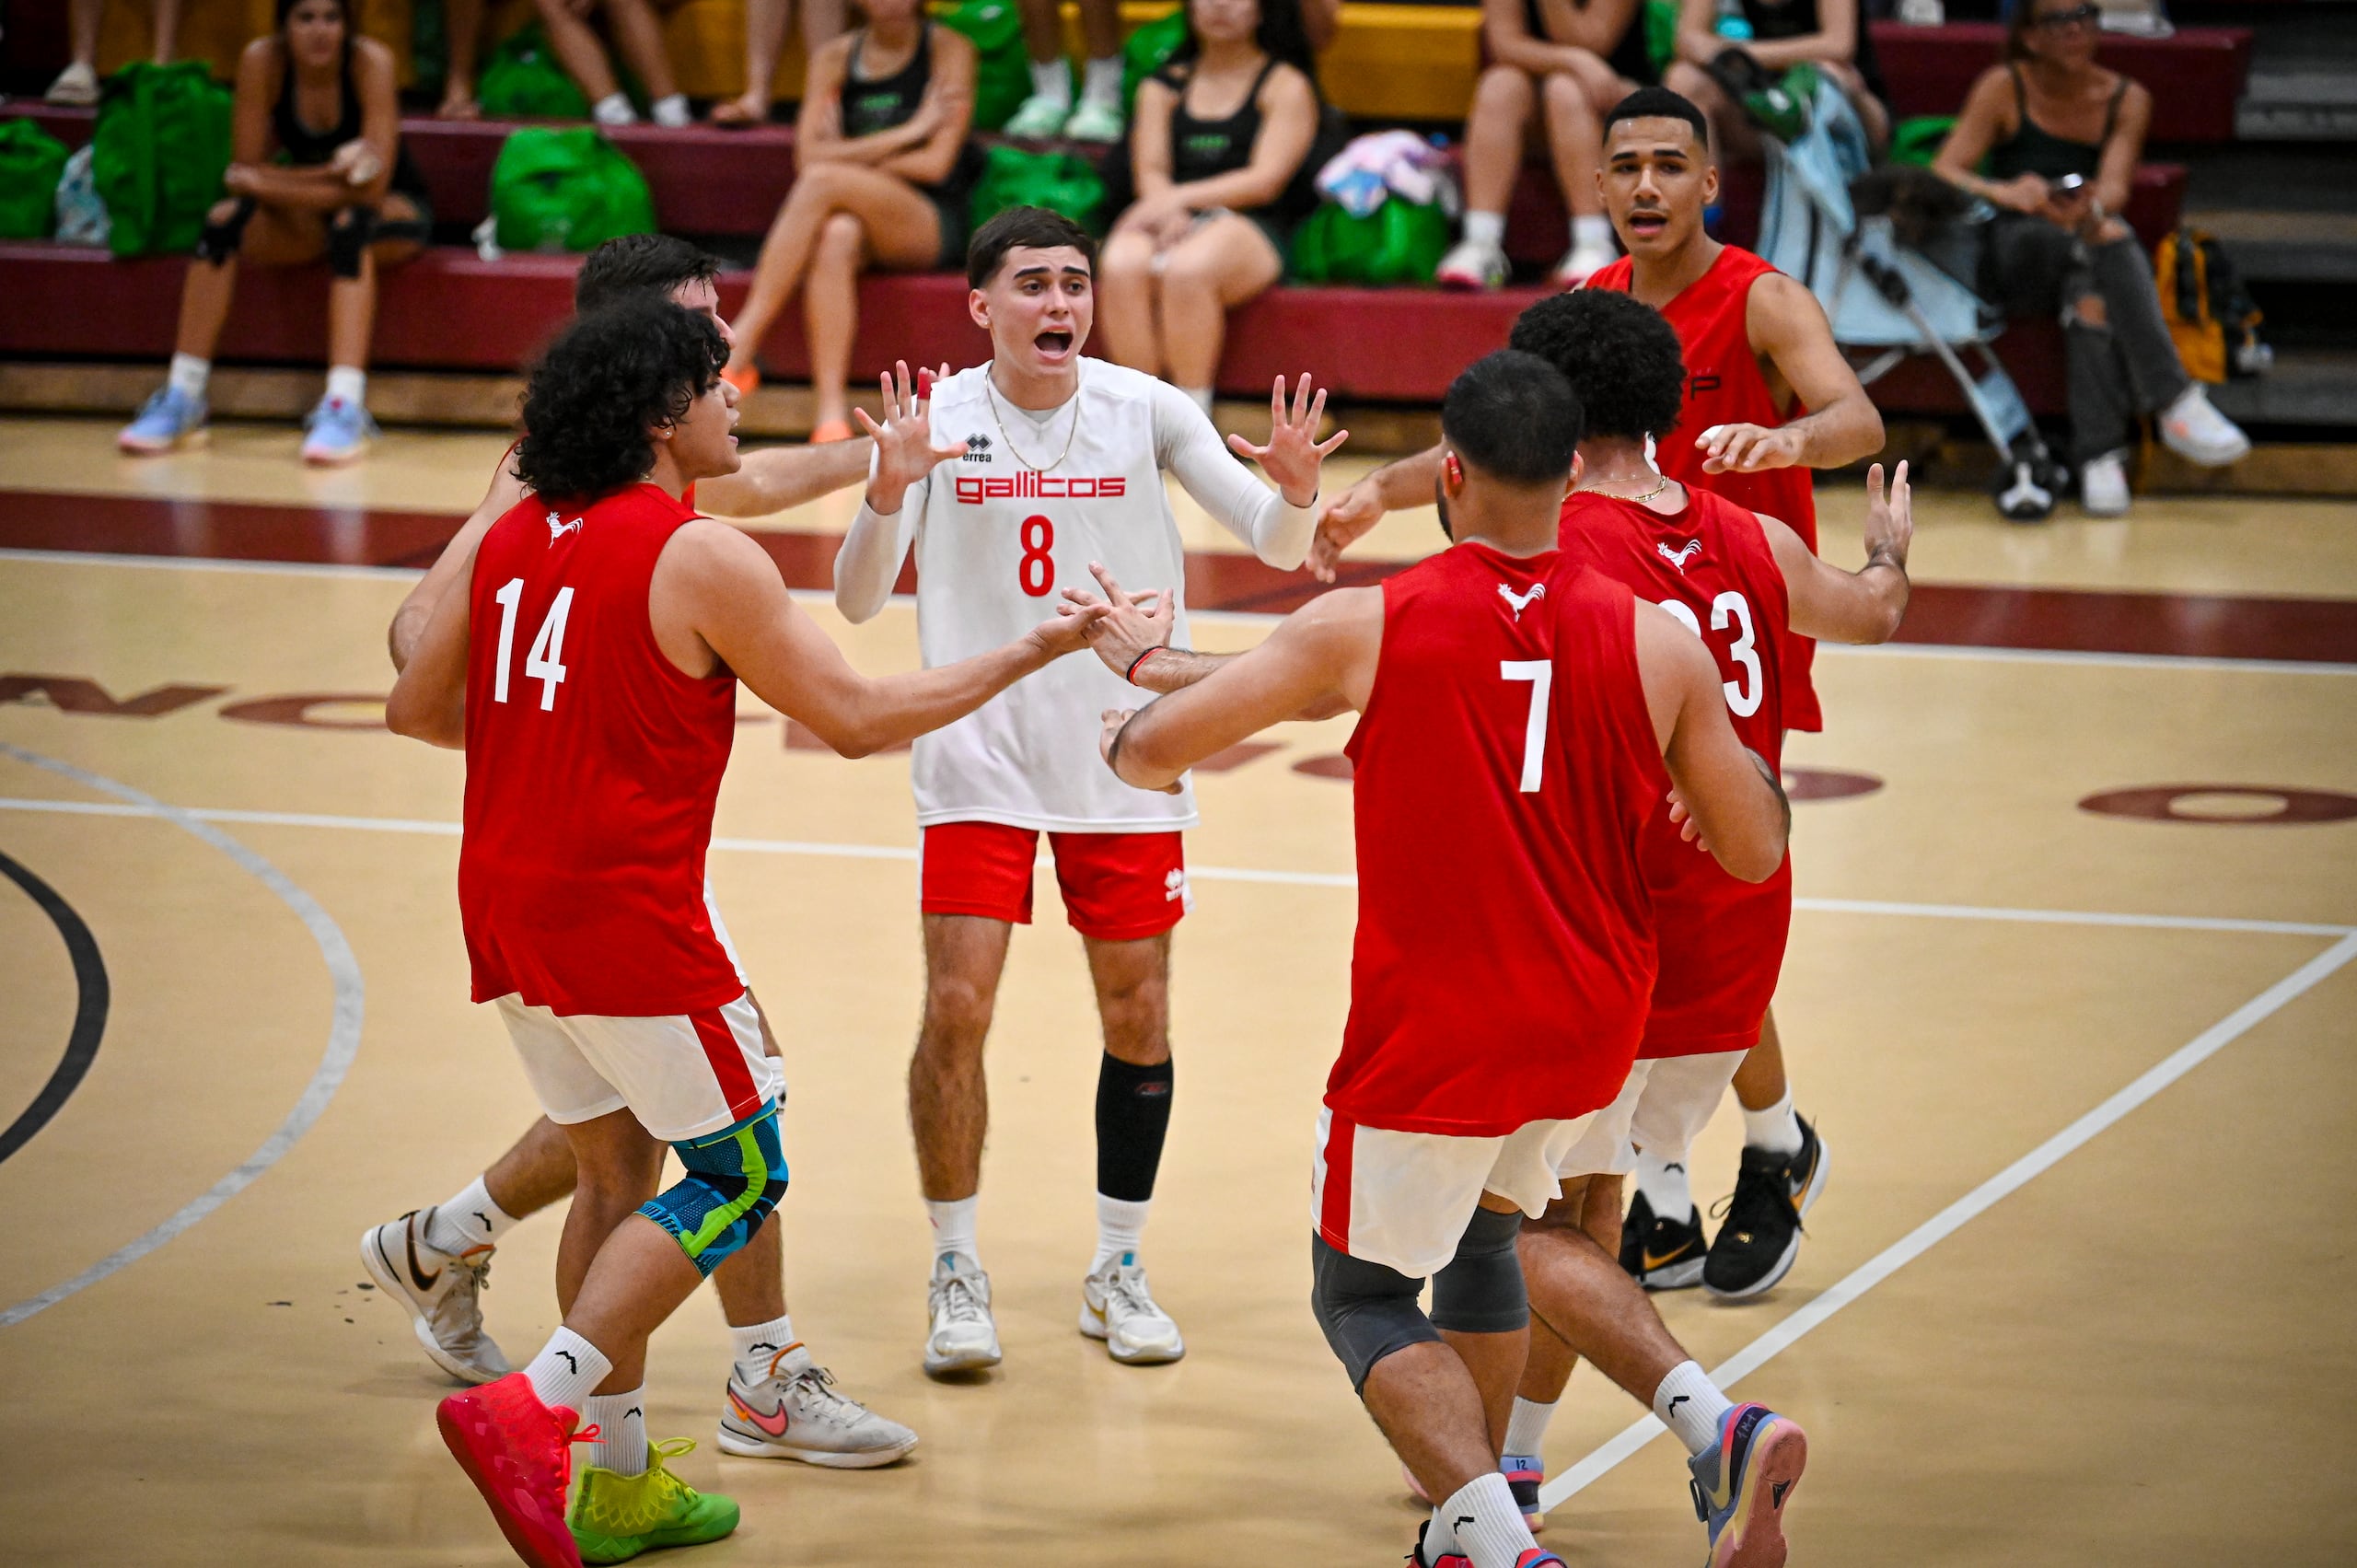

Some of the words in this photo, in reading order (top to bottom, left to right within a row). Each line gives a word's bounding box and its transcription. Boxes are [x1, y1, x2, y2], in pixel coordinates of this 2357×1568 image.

[956, 470, 1126, 505] gallitos
[1019, 514, 1055, 598] 8
[494, 577, 575, 712] 14
[1657, 590, 1763, 718] 3
[1500, 659, 1552, 793] 7
